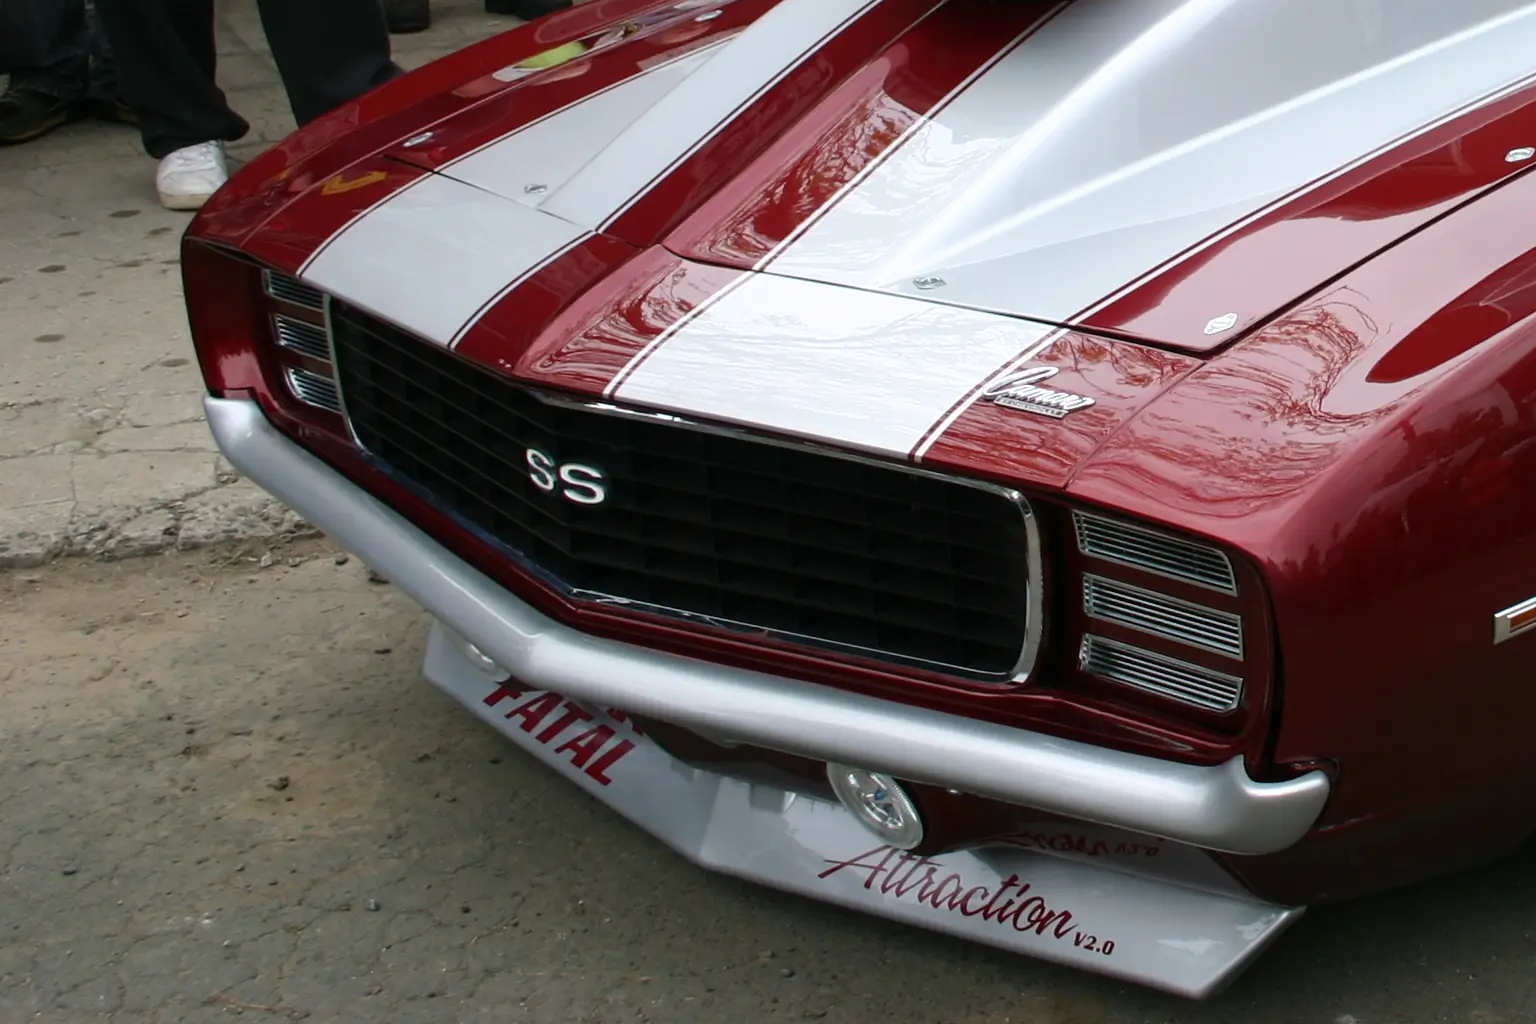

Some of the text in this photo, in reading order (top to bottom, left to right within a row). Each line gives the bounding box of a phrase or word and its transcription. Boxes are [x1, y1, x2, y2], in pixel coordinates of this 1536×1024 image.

[982, 366, 1097, 411] Camaro
[526, 448, 605, 504] SS
[818, 843, 1079, 940] Attraction
